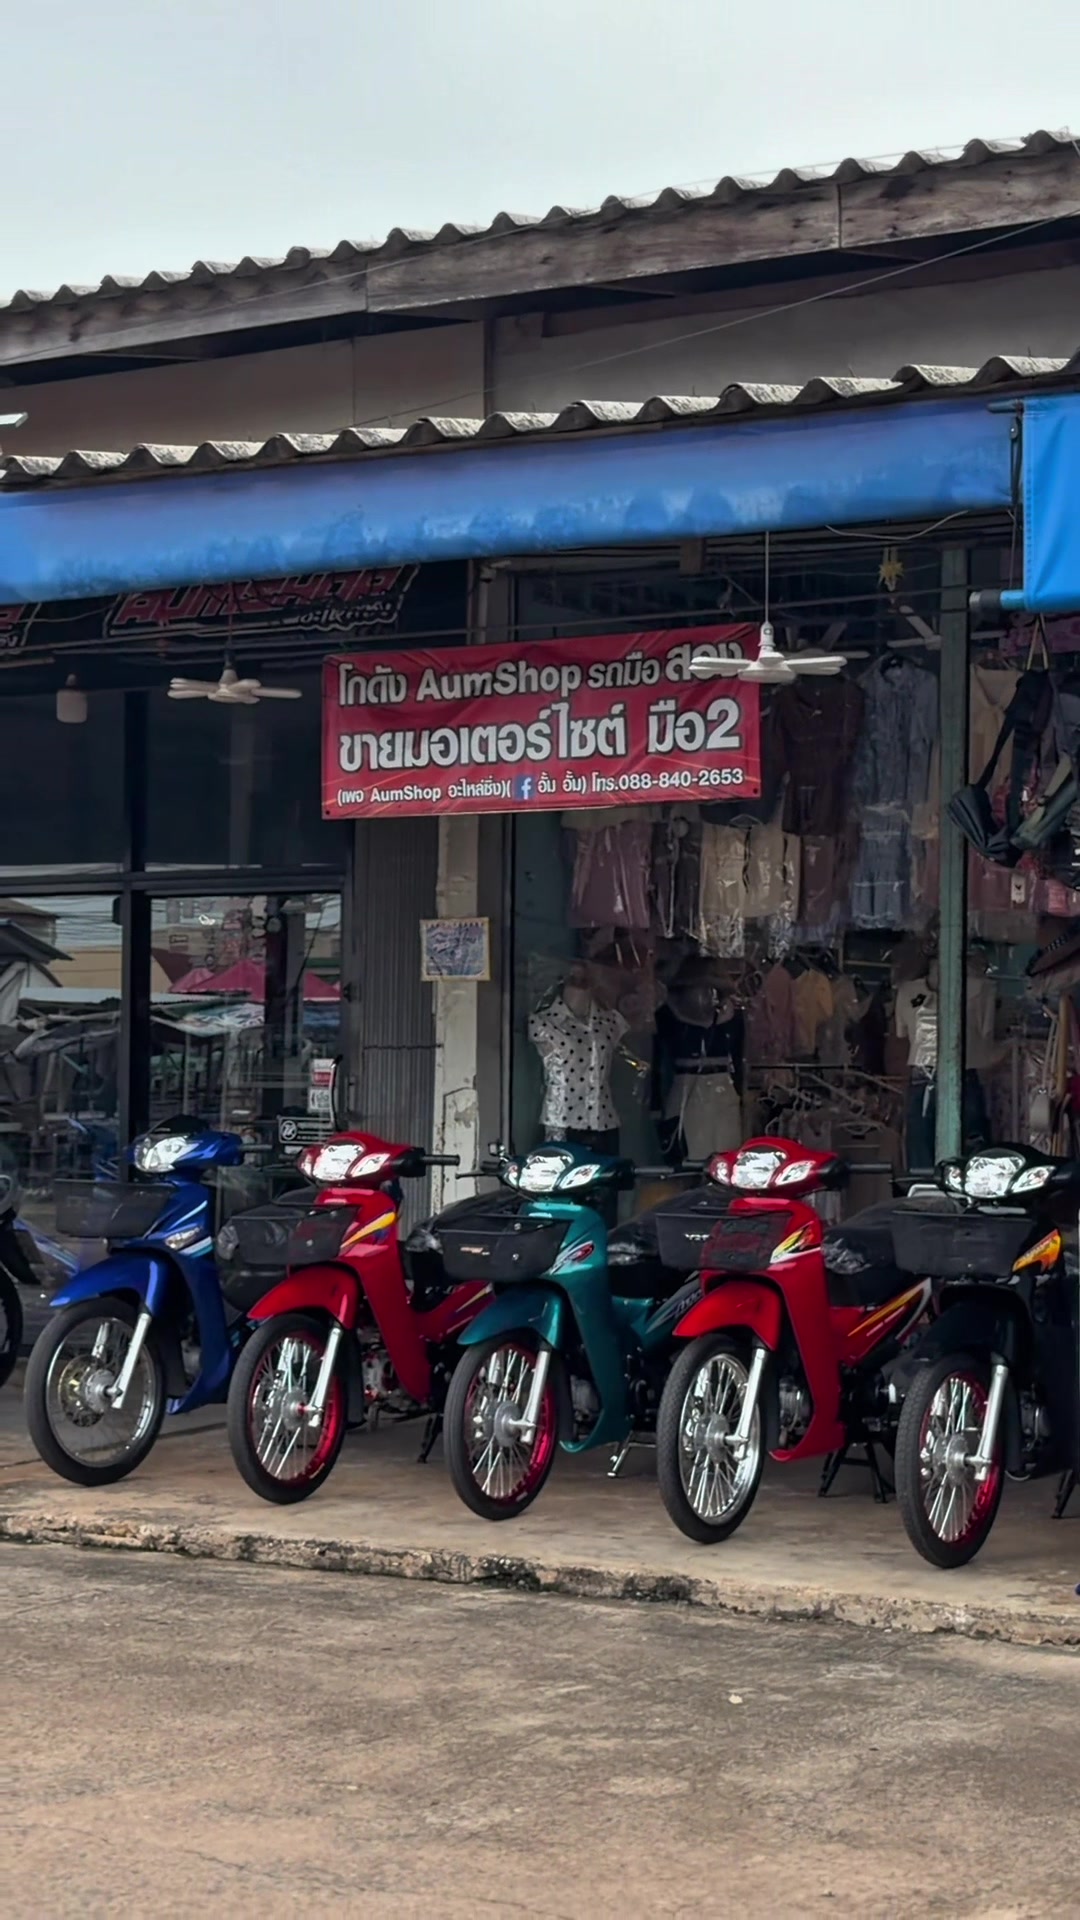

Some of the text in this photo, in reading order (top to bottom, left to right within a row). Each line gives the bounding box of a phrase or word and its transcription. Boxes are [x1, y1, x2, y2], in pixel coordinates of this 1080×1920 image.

[338, 663, 407, 706] โกดัง
[416, 660, 582, 702] AumShop
[587, 651, 660, 688] รถมือ
[339, 697, 740, 772] ขายมอเตอร์ไซต์ มือ2
[370, 785, 441, 803] AumShop
[537, 771, 556, 793] อั้ม
[562, 769, 587, 795] อั้ม)
[591, 768, 744, 792] โทร.088-840-2653
